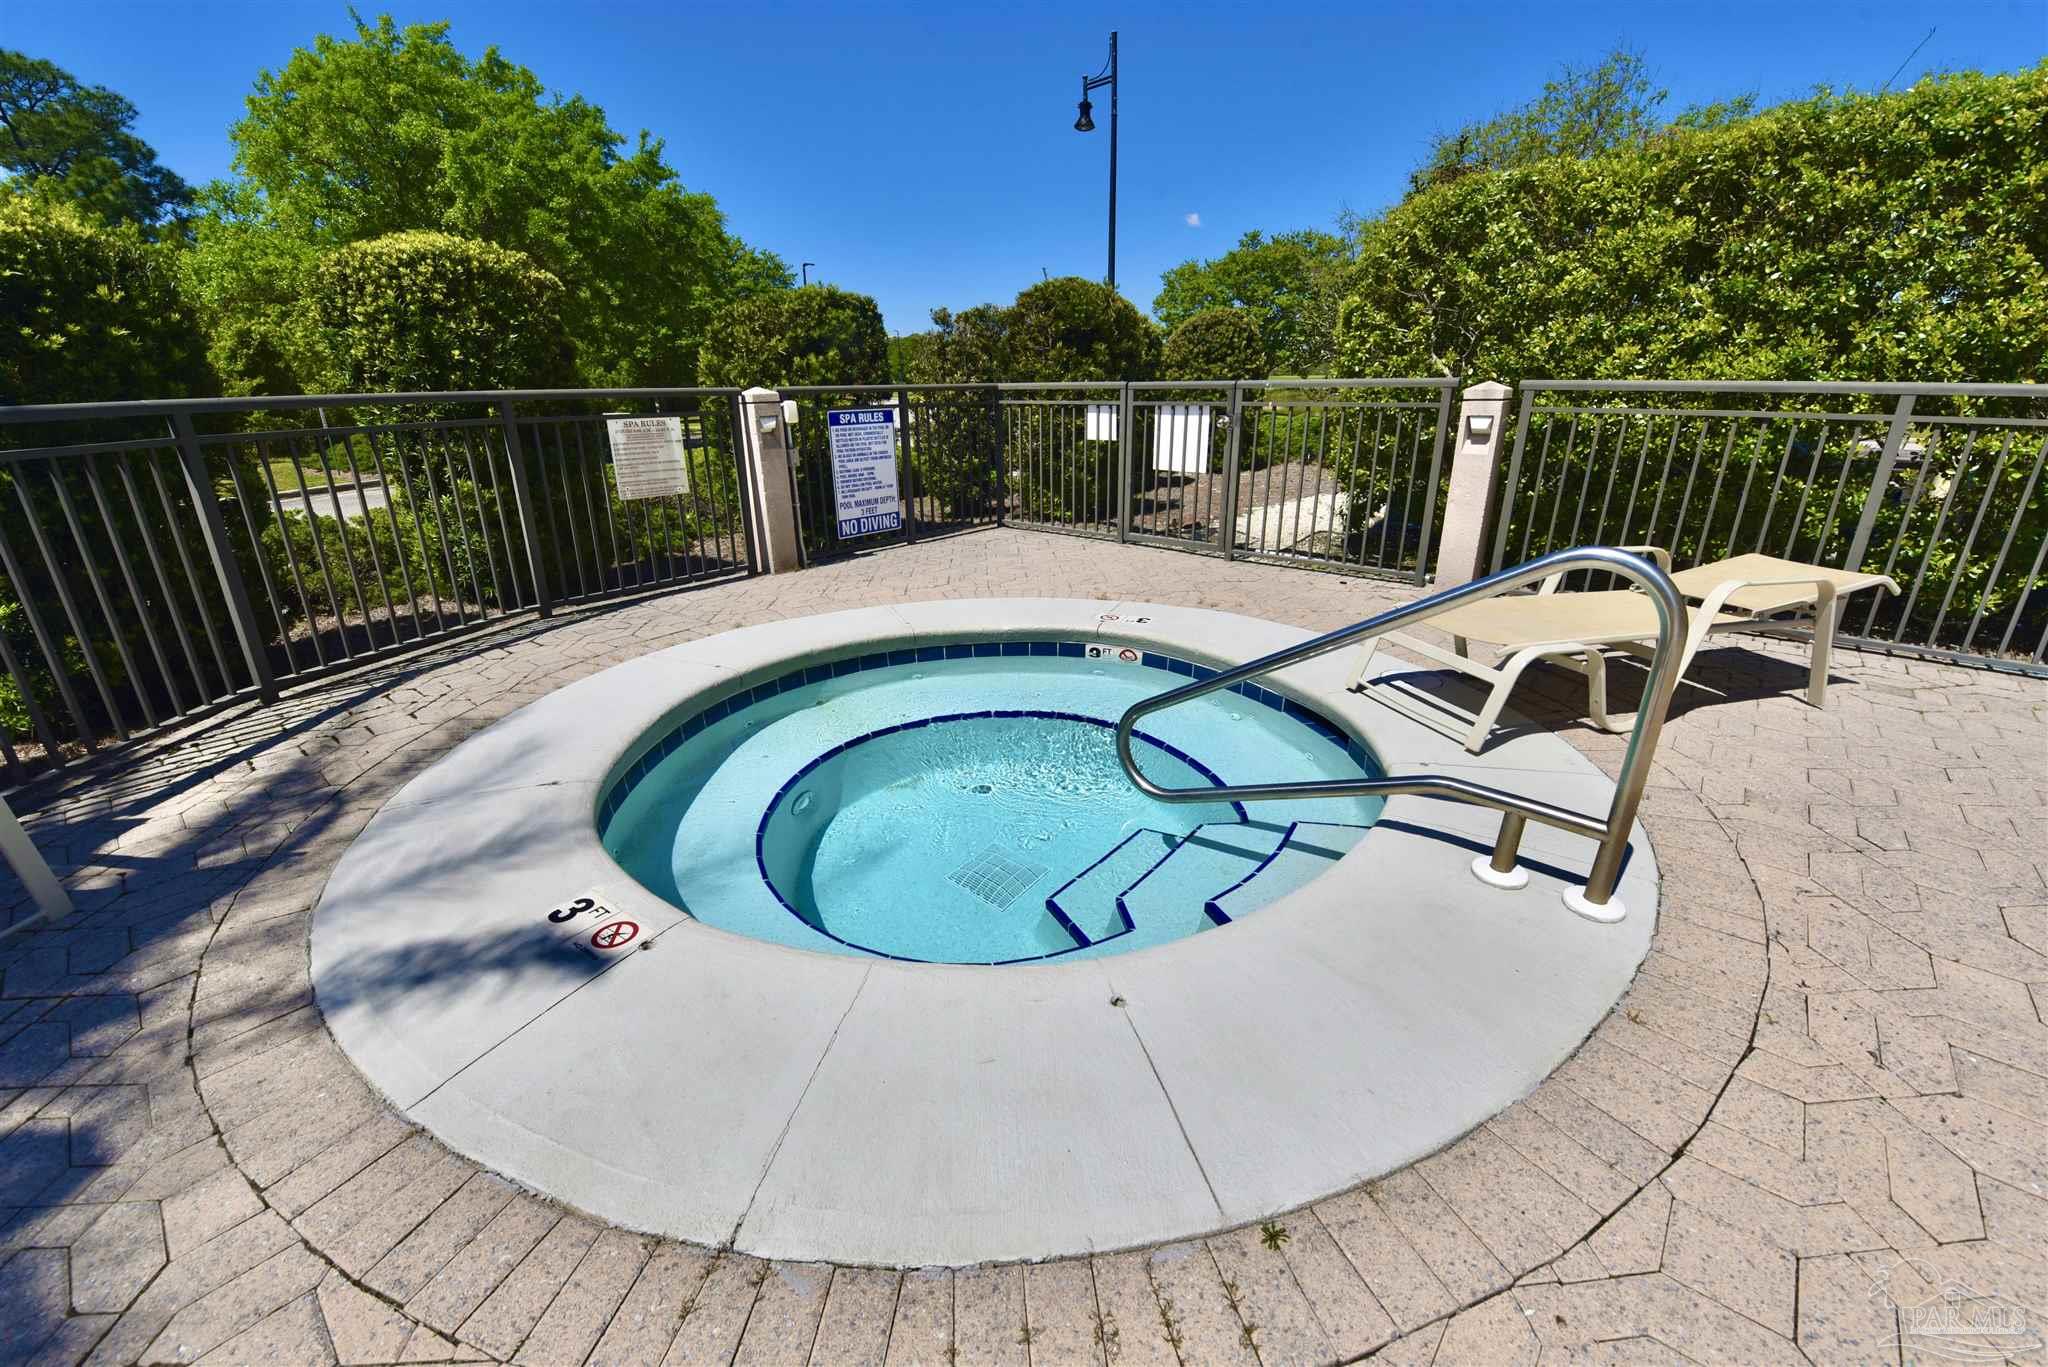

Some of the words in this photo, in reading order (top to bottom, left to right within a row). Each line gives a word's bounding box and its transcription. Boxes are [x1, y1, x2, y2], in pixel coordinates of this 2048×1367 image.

[641, 419, 666, 427] RULES
[840, 413, 857, 424] SPA
[858, 412, 884, 423] RULES
[854, 497, 879, 508] MAXIMUM
[865, 506, 878, 515] FEET
[842, 520, 858, 536] NO
[860, 513, 898, 533] DIVING
[1089, 647, 1101, 658] 3
[547, 898, 595, 923] 3
[588, 905, 611, 919] FT
